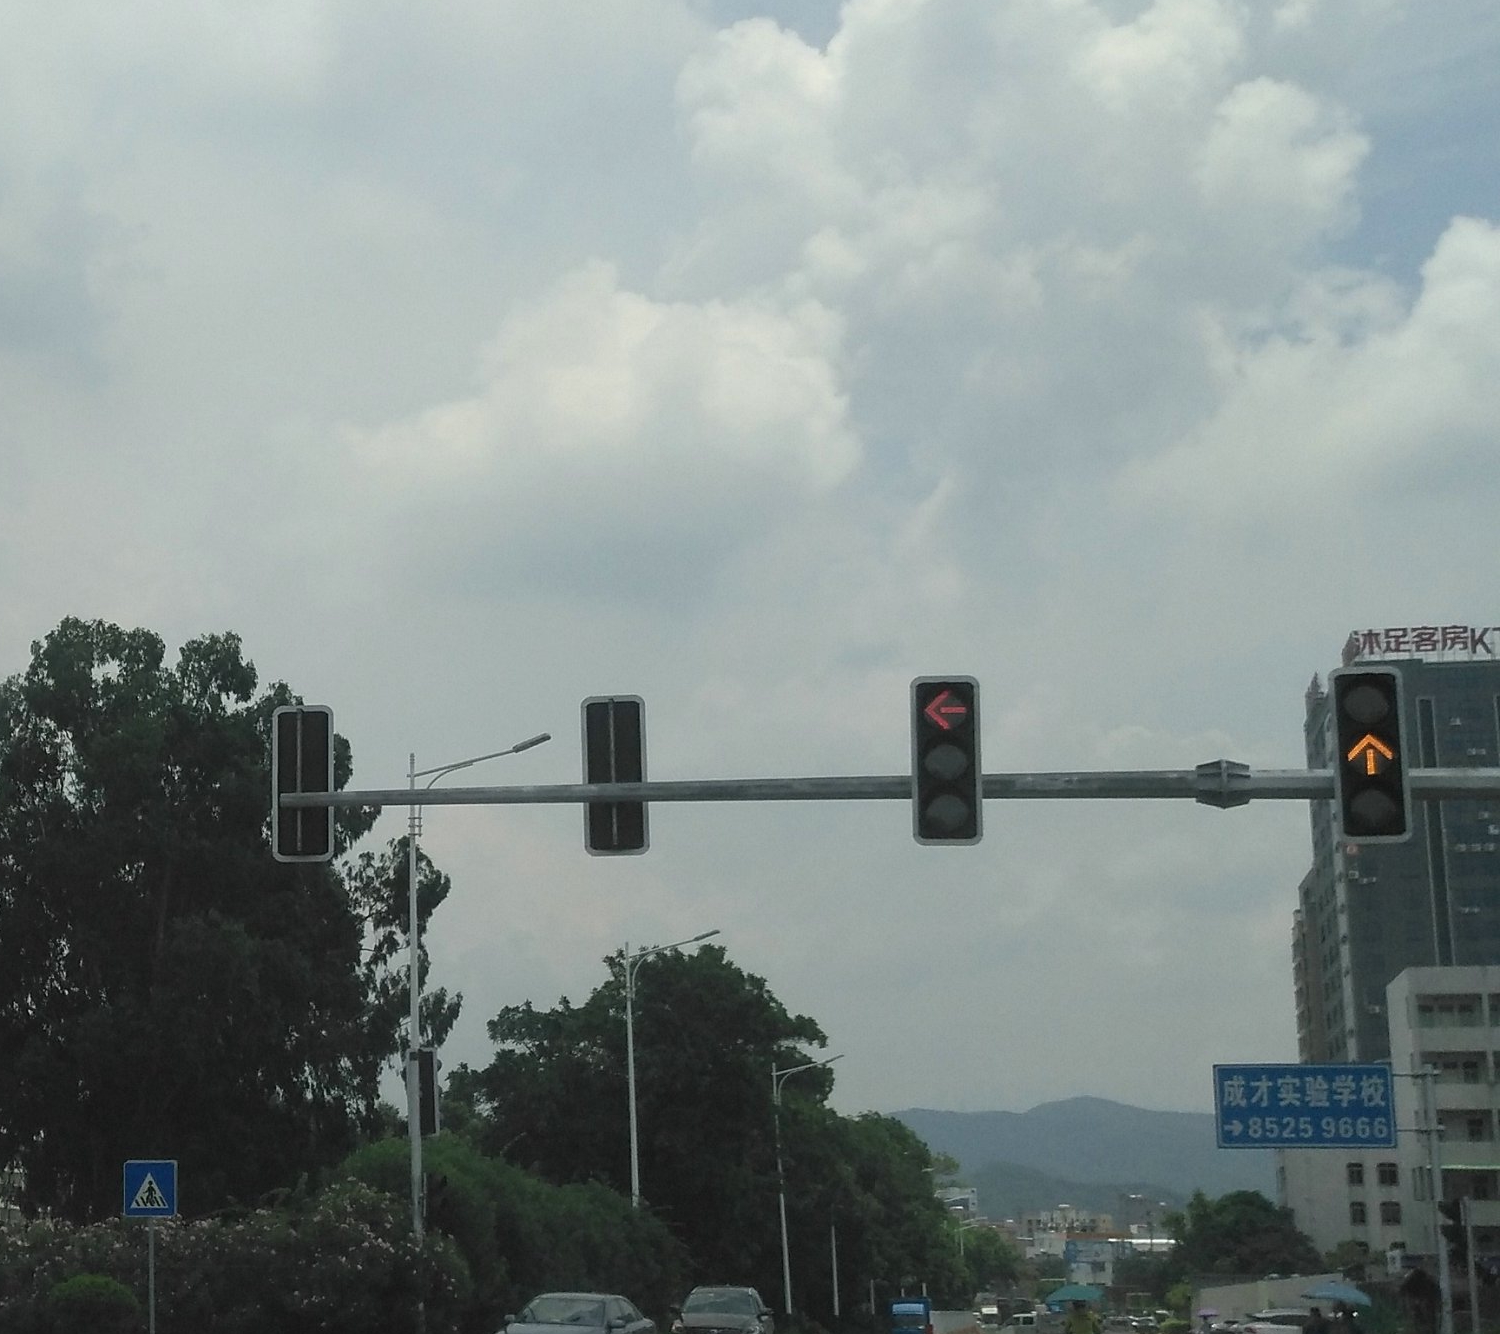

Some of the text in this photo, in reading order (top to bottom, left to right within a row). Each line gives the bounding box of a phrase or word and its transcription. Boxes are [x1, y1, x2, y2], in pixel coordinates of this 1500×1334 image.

[1223, 1075, 1386, 1107] 成才实验学校
[1249, 1116, 1388, 1138] 8525 9666
